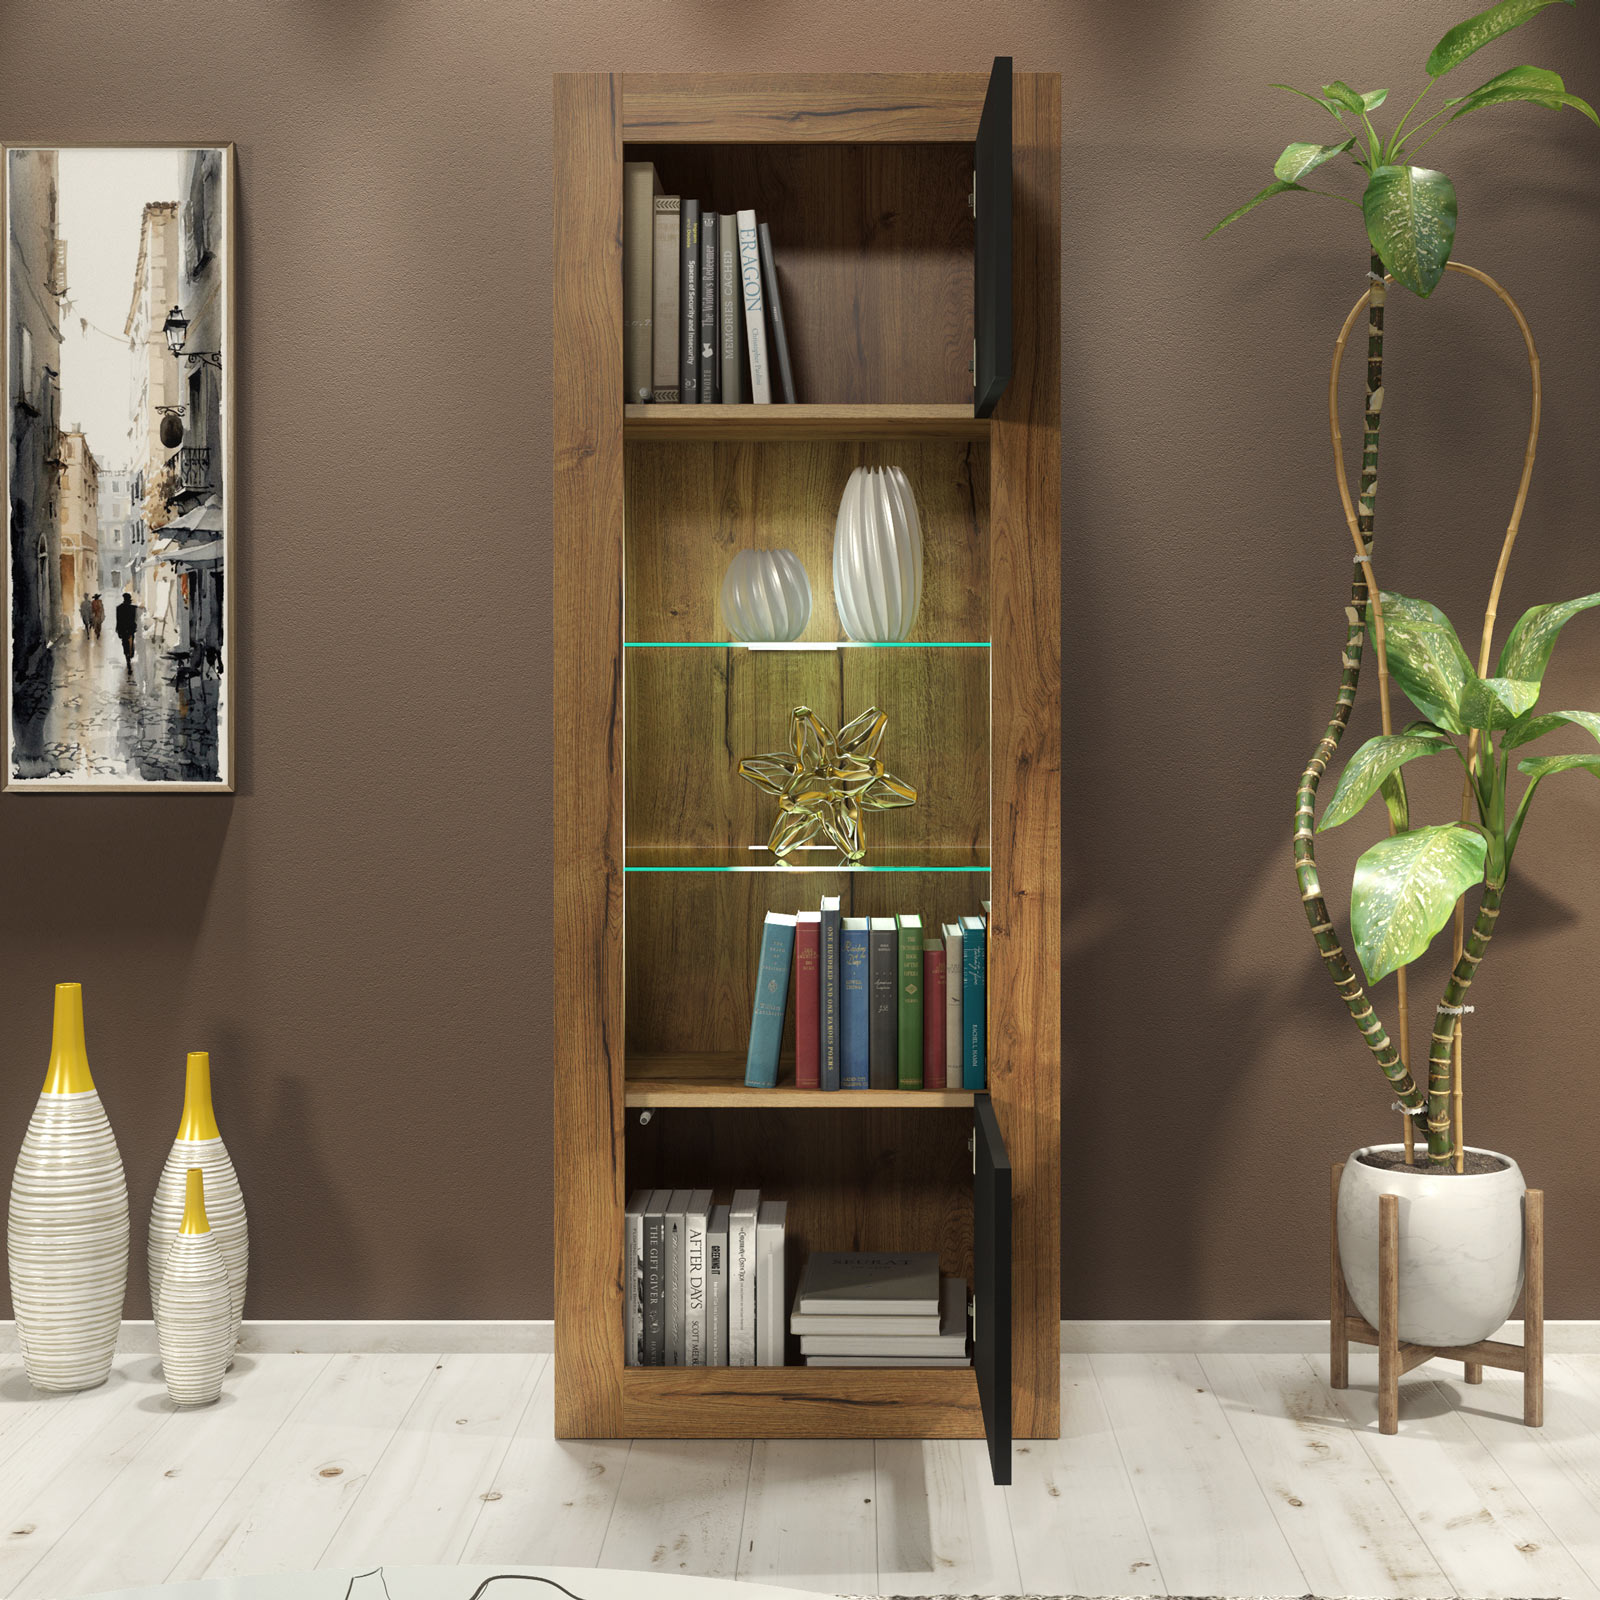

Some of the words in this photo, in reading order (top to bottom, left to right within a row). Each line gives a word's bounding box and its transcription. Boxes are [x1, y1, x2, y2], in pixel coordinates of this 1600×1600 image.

[687, 260, 695, 282] Spaces
[704, 245, 715, 280] Redeemer
[723, 251, 733, 295] CACHED
[739, 228, 762, 312] ERAGON
[686, 291, 696, 318] Security
[704, 282, 714, 311] Widow's
[703, 313, 713, 327] The
[725, 301, 734, 359] MEMORIES
[686, 332, 695, 364] Insecurity
[751, 328, 761, 363] Christopher
[650, 1225, 658, 1245] THE
[650, 1248, 658, 1270] GIFT
[690, 1229, 702, 1274] AFTER
[711, 1245, 720, 1269] GREENING
[650, 1274, 658, 1304] GIVER
[690, 1277, 703, 1309] DAYS
